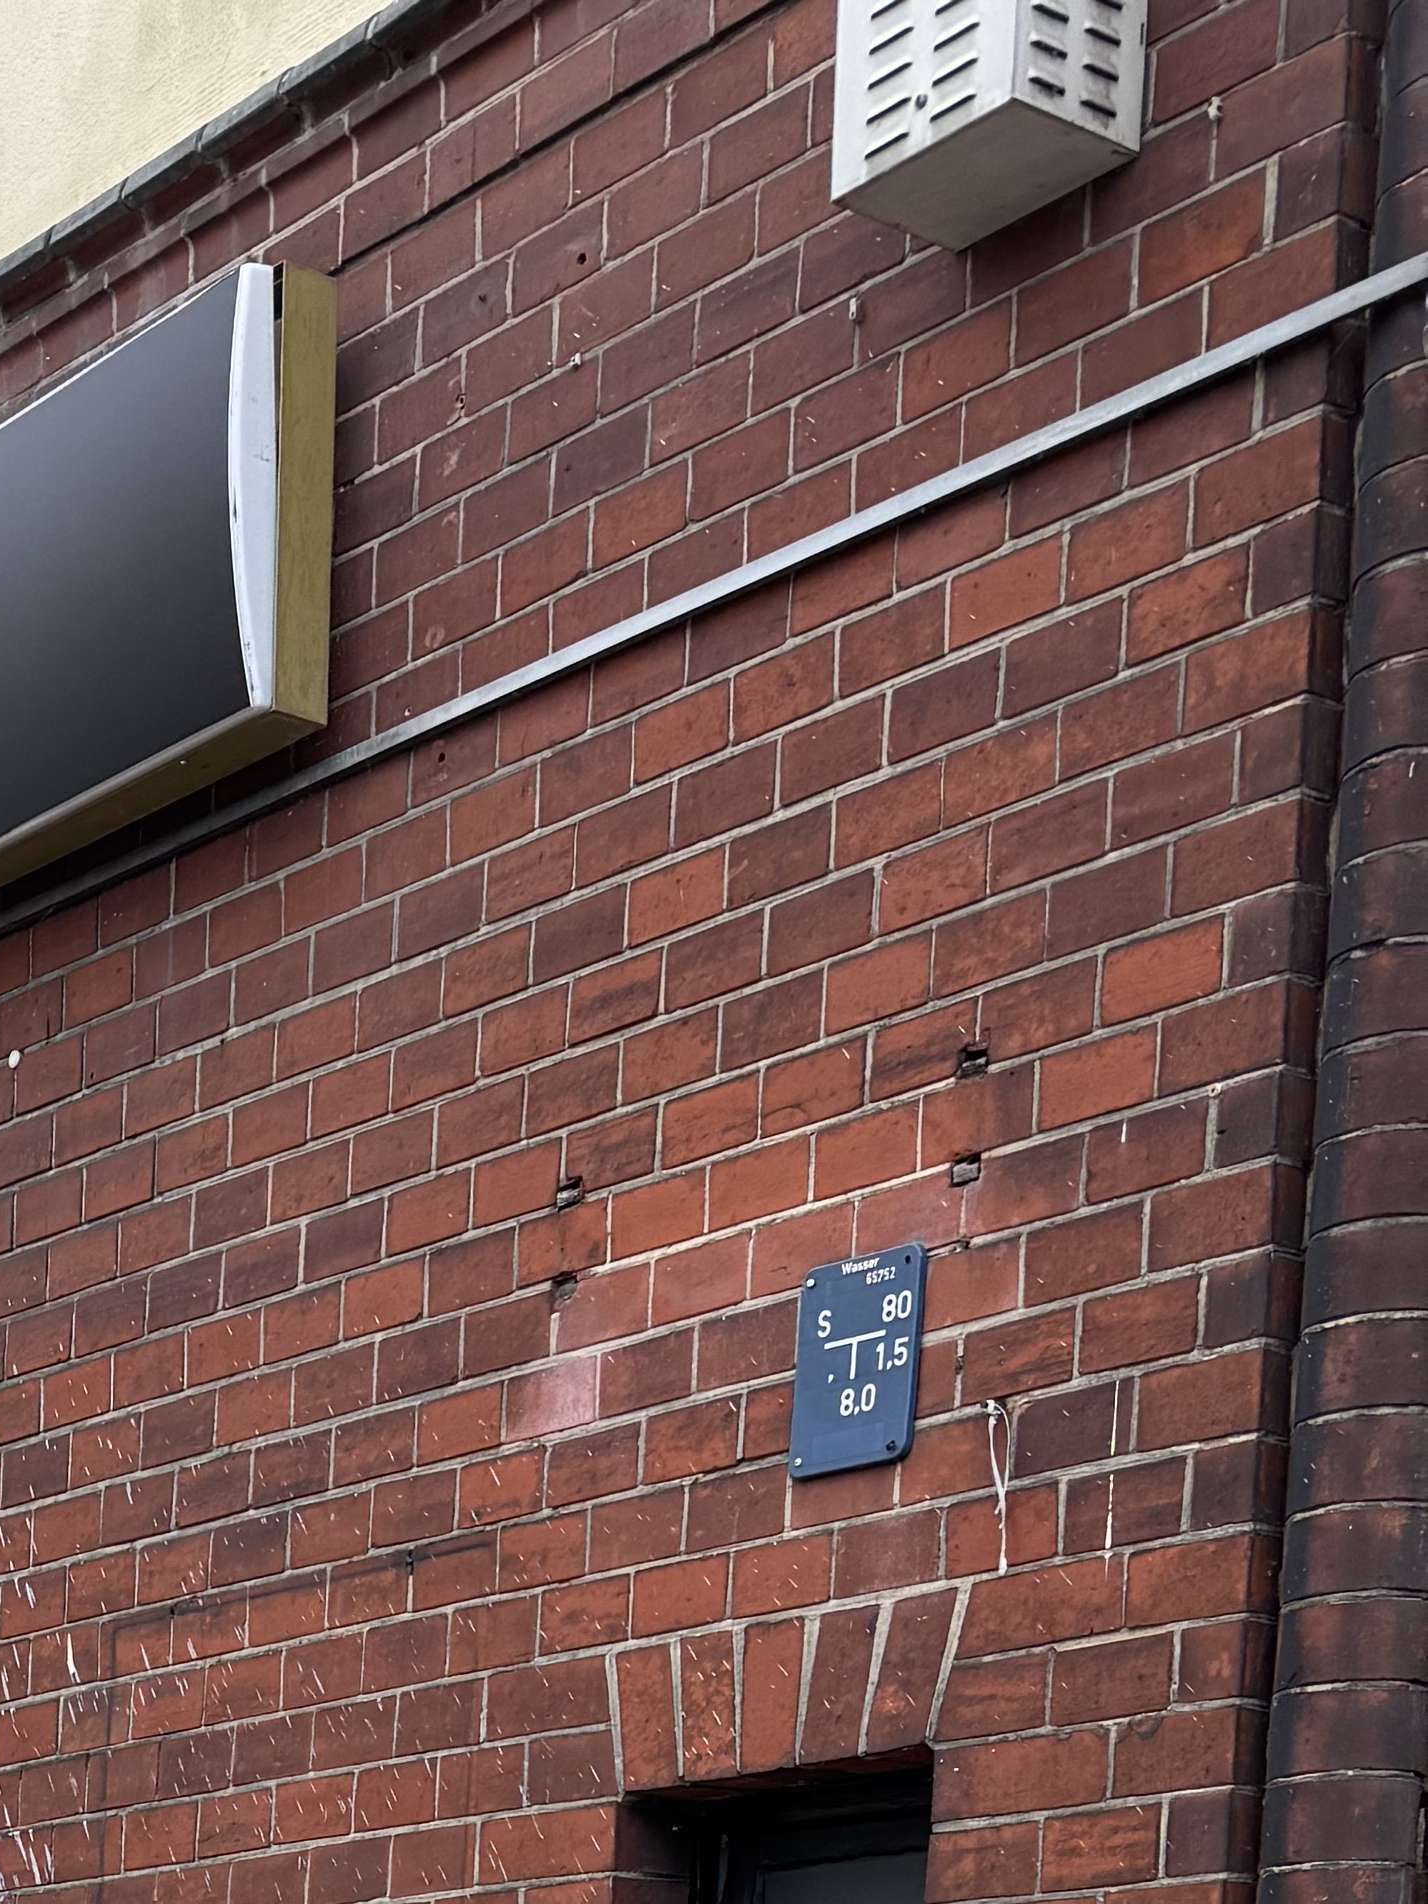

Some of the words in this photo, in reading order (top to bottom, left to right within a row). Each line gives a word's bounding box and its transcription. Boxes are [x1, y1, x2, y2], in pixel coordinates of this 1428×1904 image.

[841, 1257, 880, 1276] Wasser
[865, 1266, 896, 1285] 65752
[817, 1310, 832, 1338] S
[881, 1289, 912, 1323] 80
[875, 1336, 909, 1371] 1,5
[839, 1383, 876, 1417] 8,0
